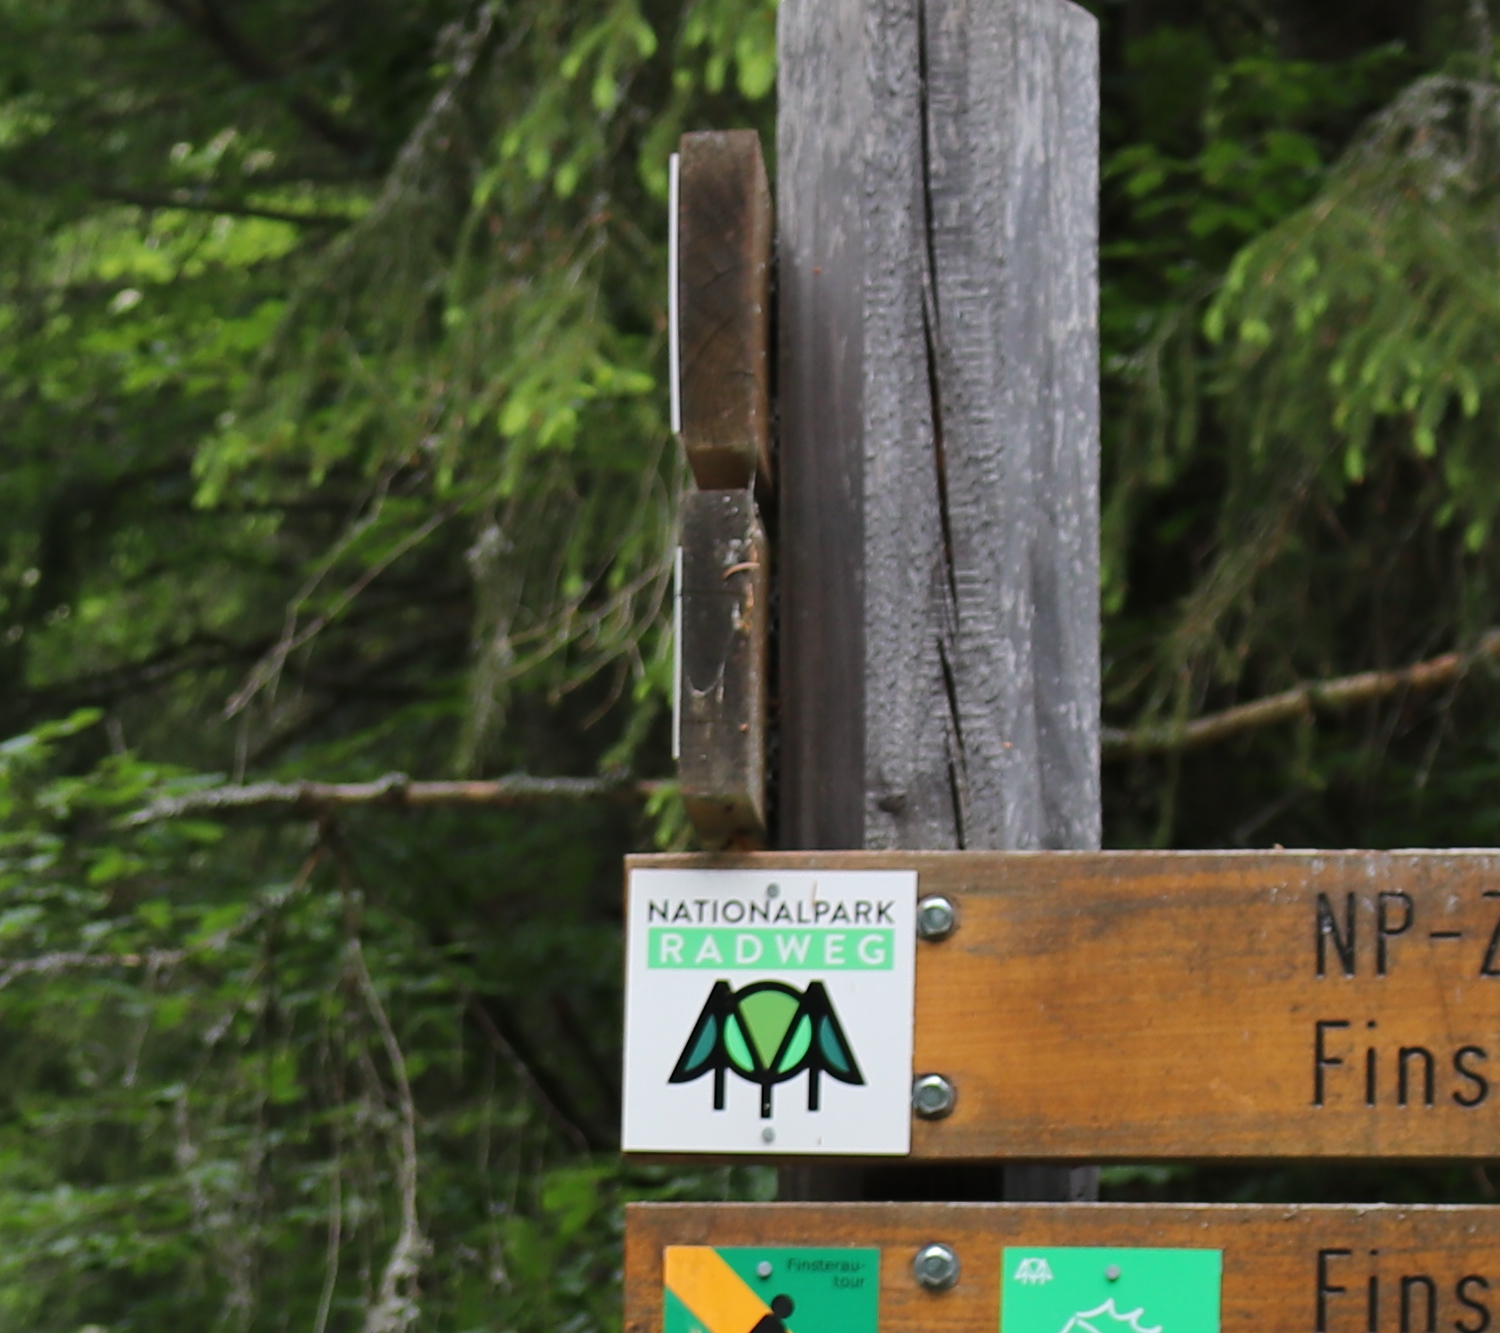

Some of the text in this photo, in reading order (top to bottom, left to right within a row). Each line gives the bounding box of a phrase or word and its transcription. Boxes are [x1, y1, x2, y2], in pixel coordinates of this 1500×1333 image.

[648, 899, 895, 924] NATIONALPARK
[659, 933, 887, 965] RADWEG
[787, 1257, 867, 1272] Finsterau-
[833, 1276, 865, 1288] tour
